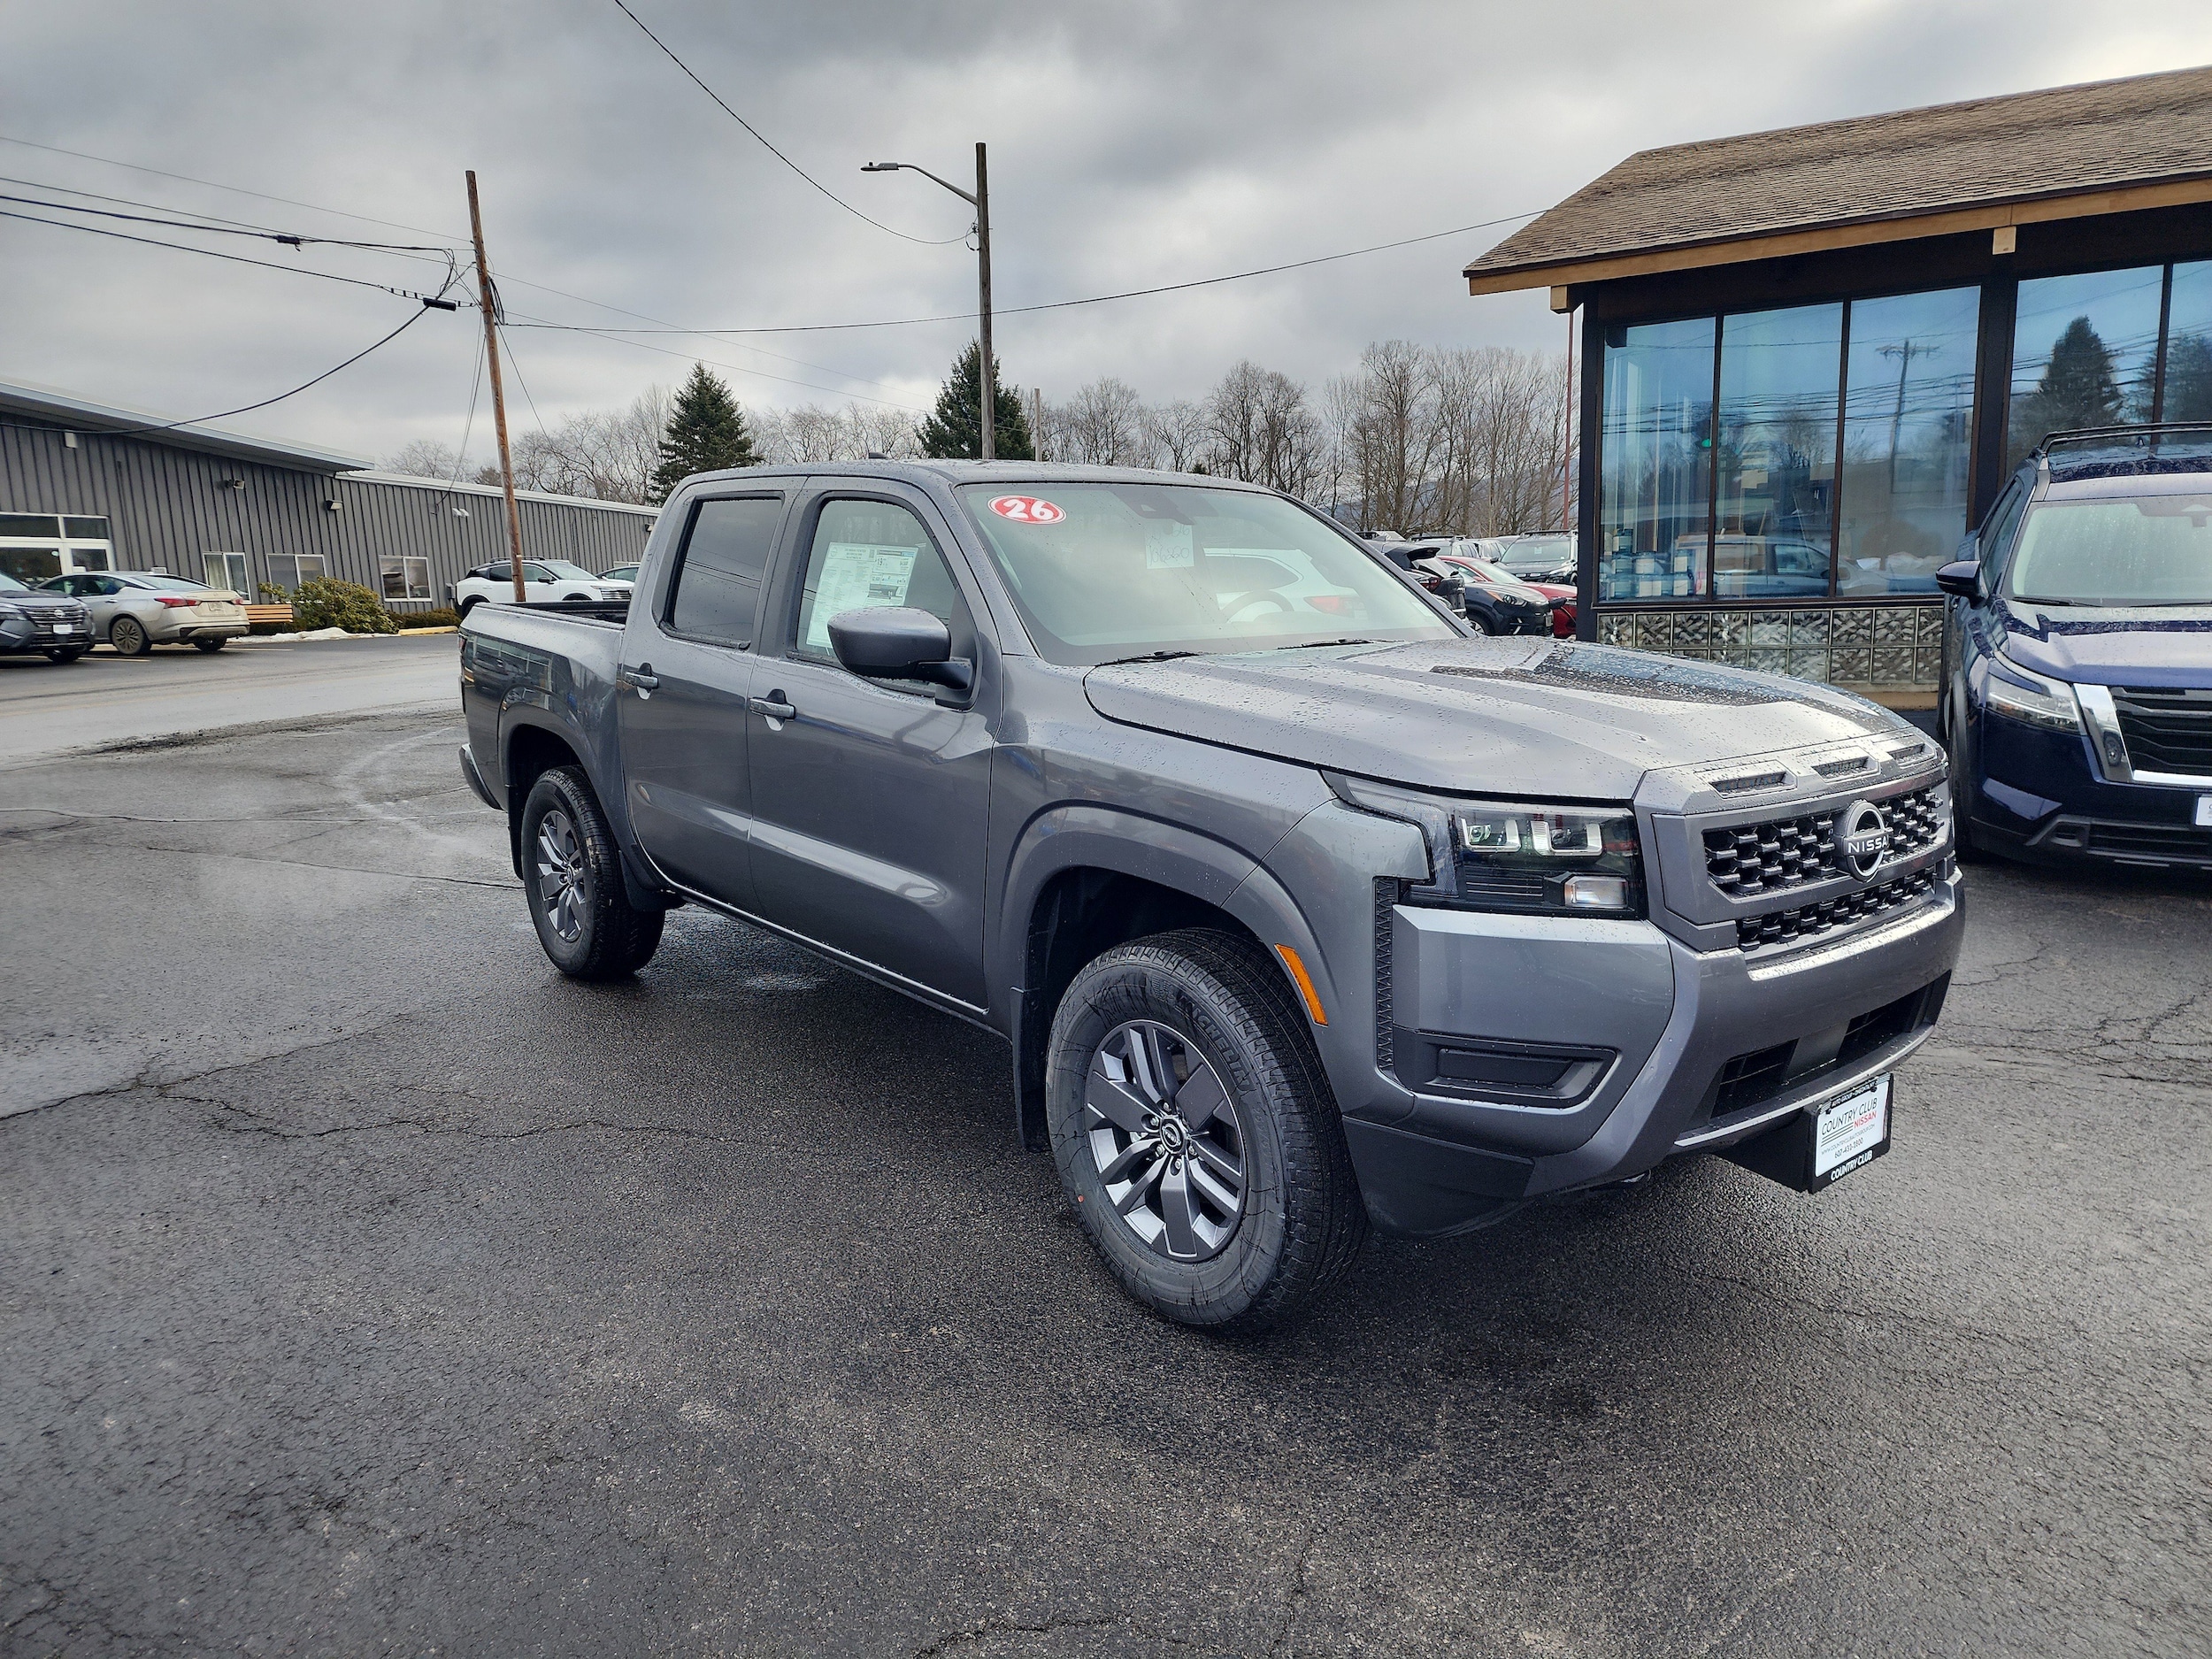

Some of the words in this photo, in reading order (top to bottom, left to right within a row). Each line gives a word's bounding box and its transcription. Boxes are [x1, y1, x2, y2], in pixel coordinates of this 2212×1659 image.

[1002, 498, 1054, 520] 26
[1821, 1107, 1859, 1135] COUNTRY
[1859, 1097, 1878, 1116] CLUB
[1854, 1110, 1877, 1129] NISSAN
[1830, 1158, 1858, 1181] COUNTRY
[1857, 1149, 1874, 1167] CLUB
